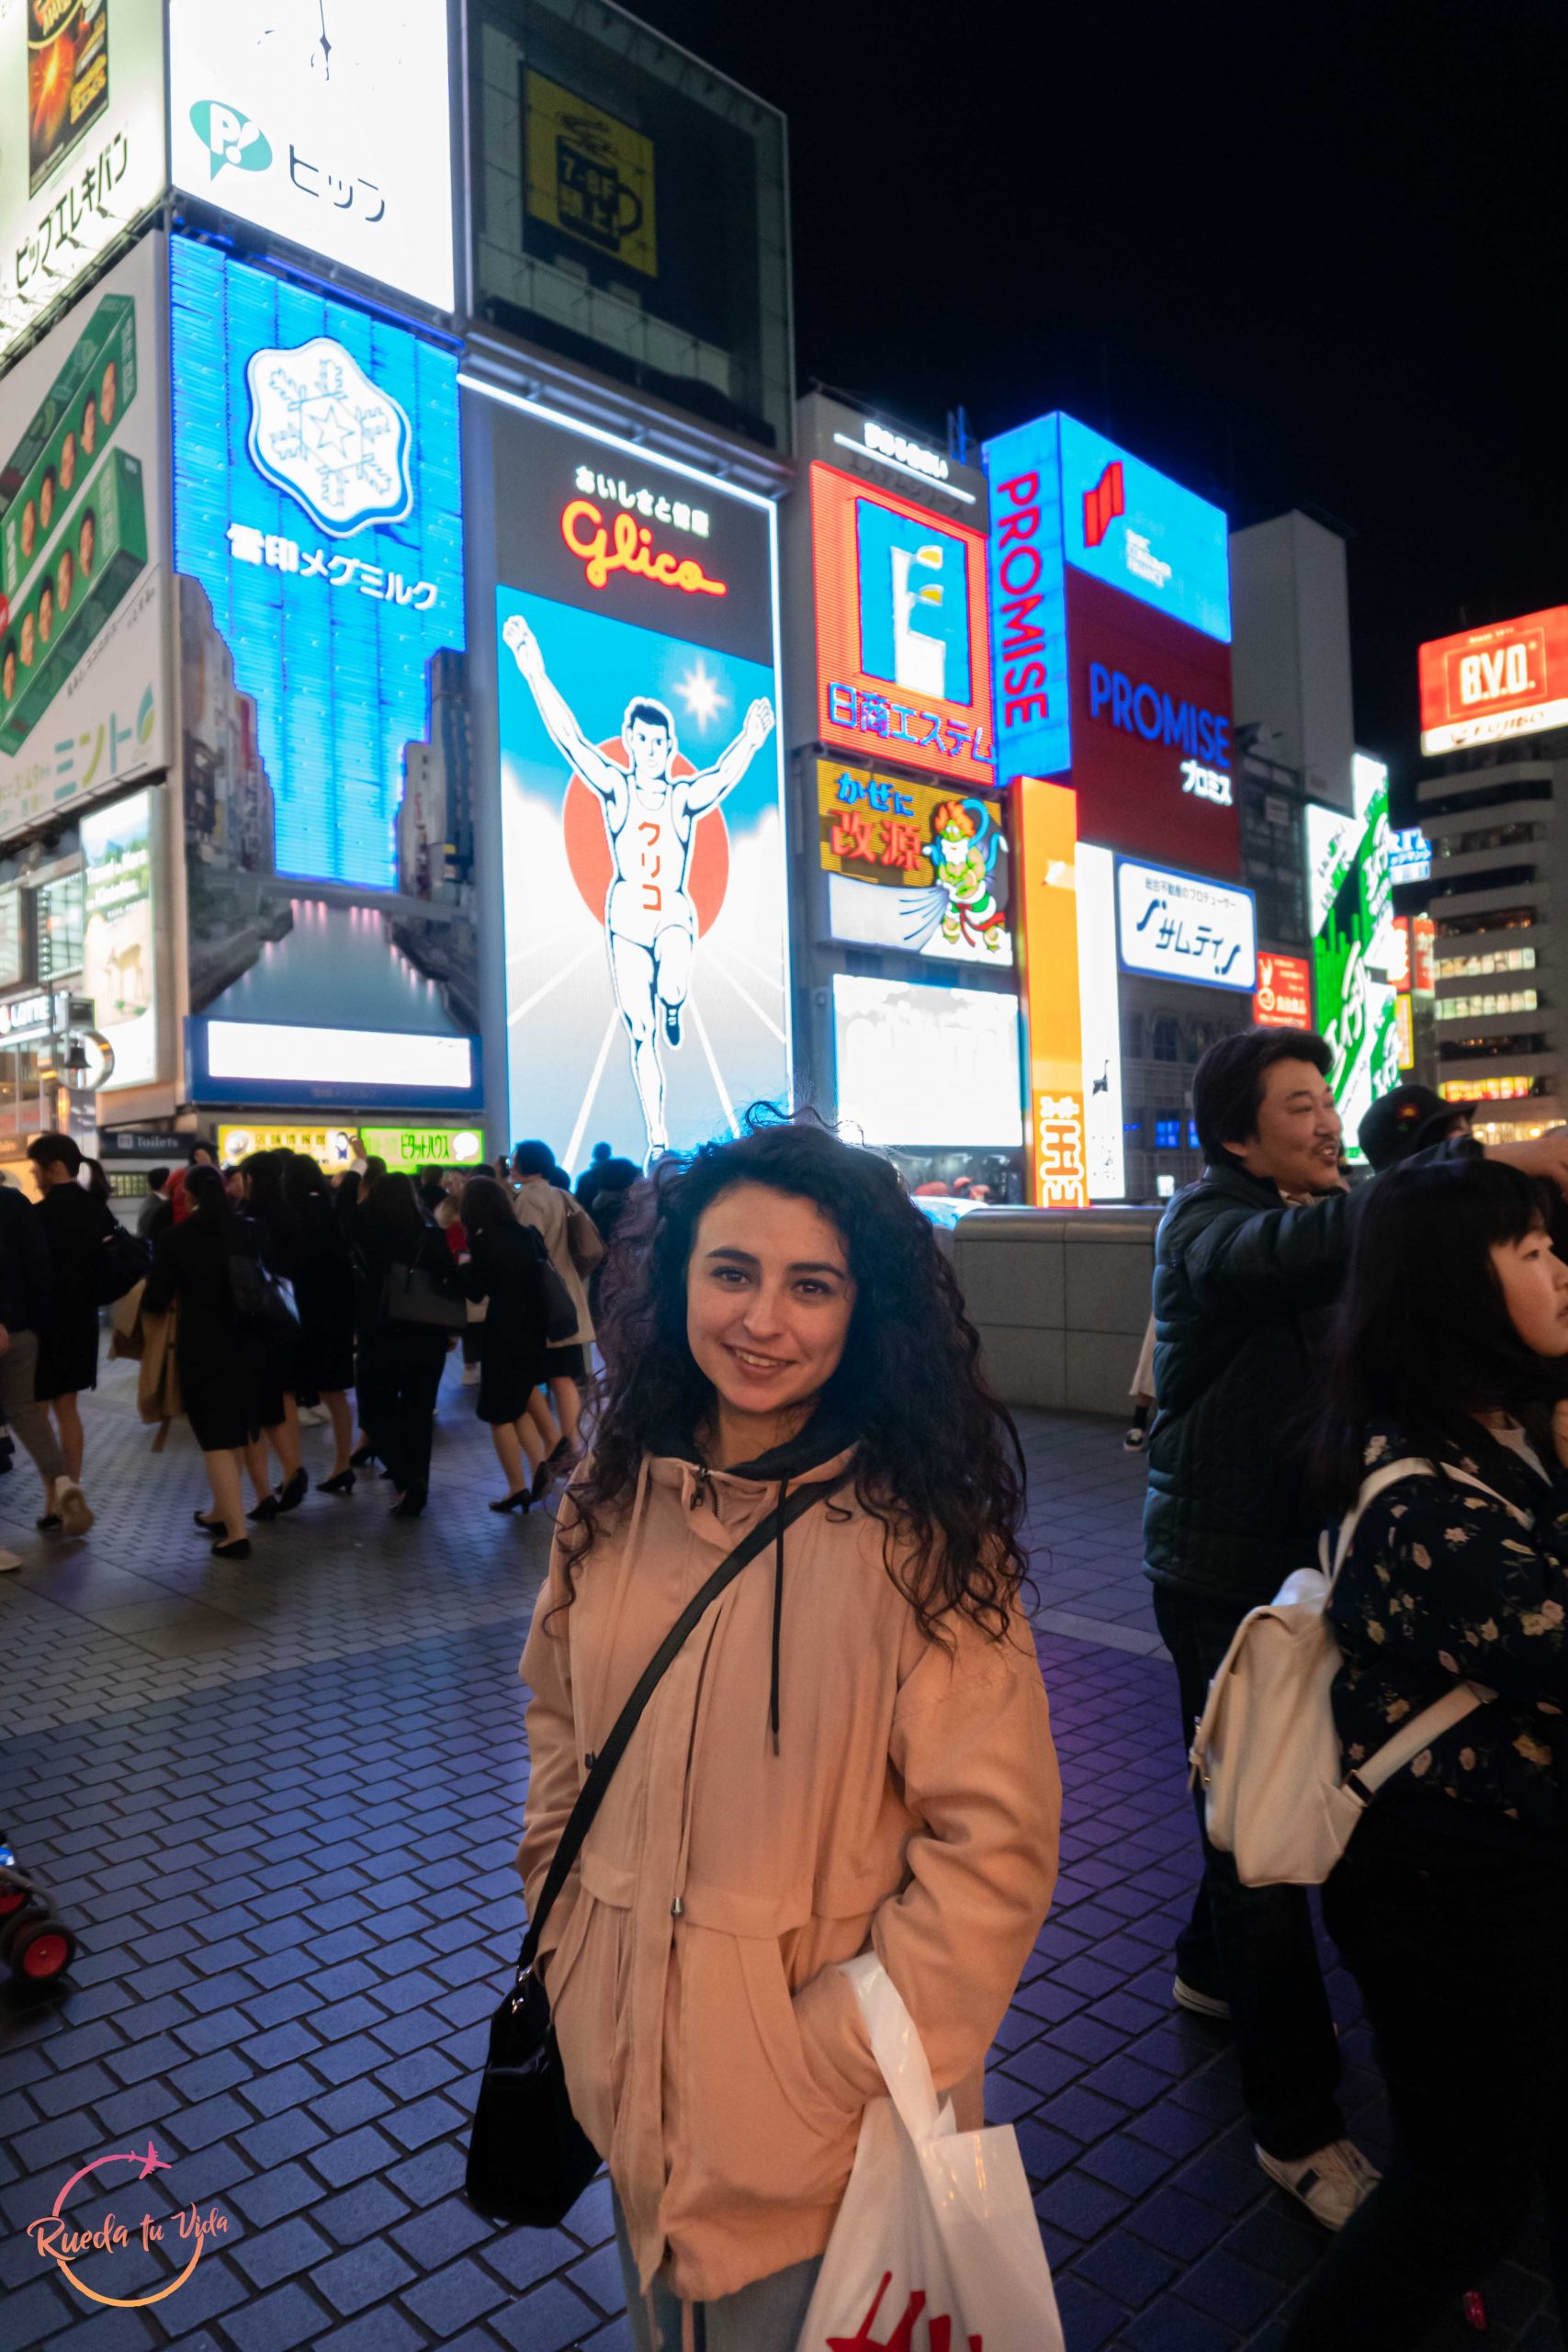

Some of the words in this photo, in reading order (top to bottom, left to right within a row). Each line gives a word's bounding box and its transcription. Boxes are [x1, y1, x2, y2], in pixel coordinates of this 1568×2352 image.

[559, 499, 728, 596] Glico
[997, 469, 1049, 728] PROMISE
[1460, 643, 1536, 706] B.V.D.
[828, 681, 998, 766] 日商エステム
[1090, 661, 1231, 768] PROMISE
[54, 712, 132, 801] ミント
[837, 772, 915, 818] かぜに
[829, 809, 922, 872] 改源
[1155, 918, 1224, 959] サムティ
[138, 1136, 178, 1148] Toilets
